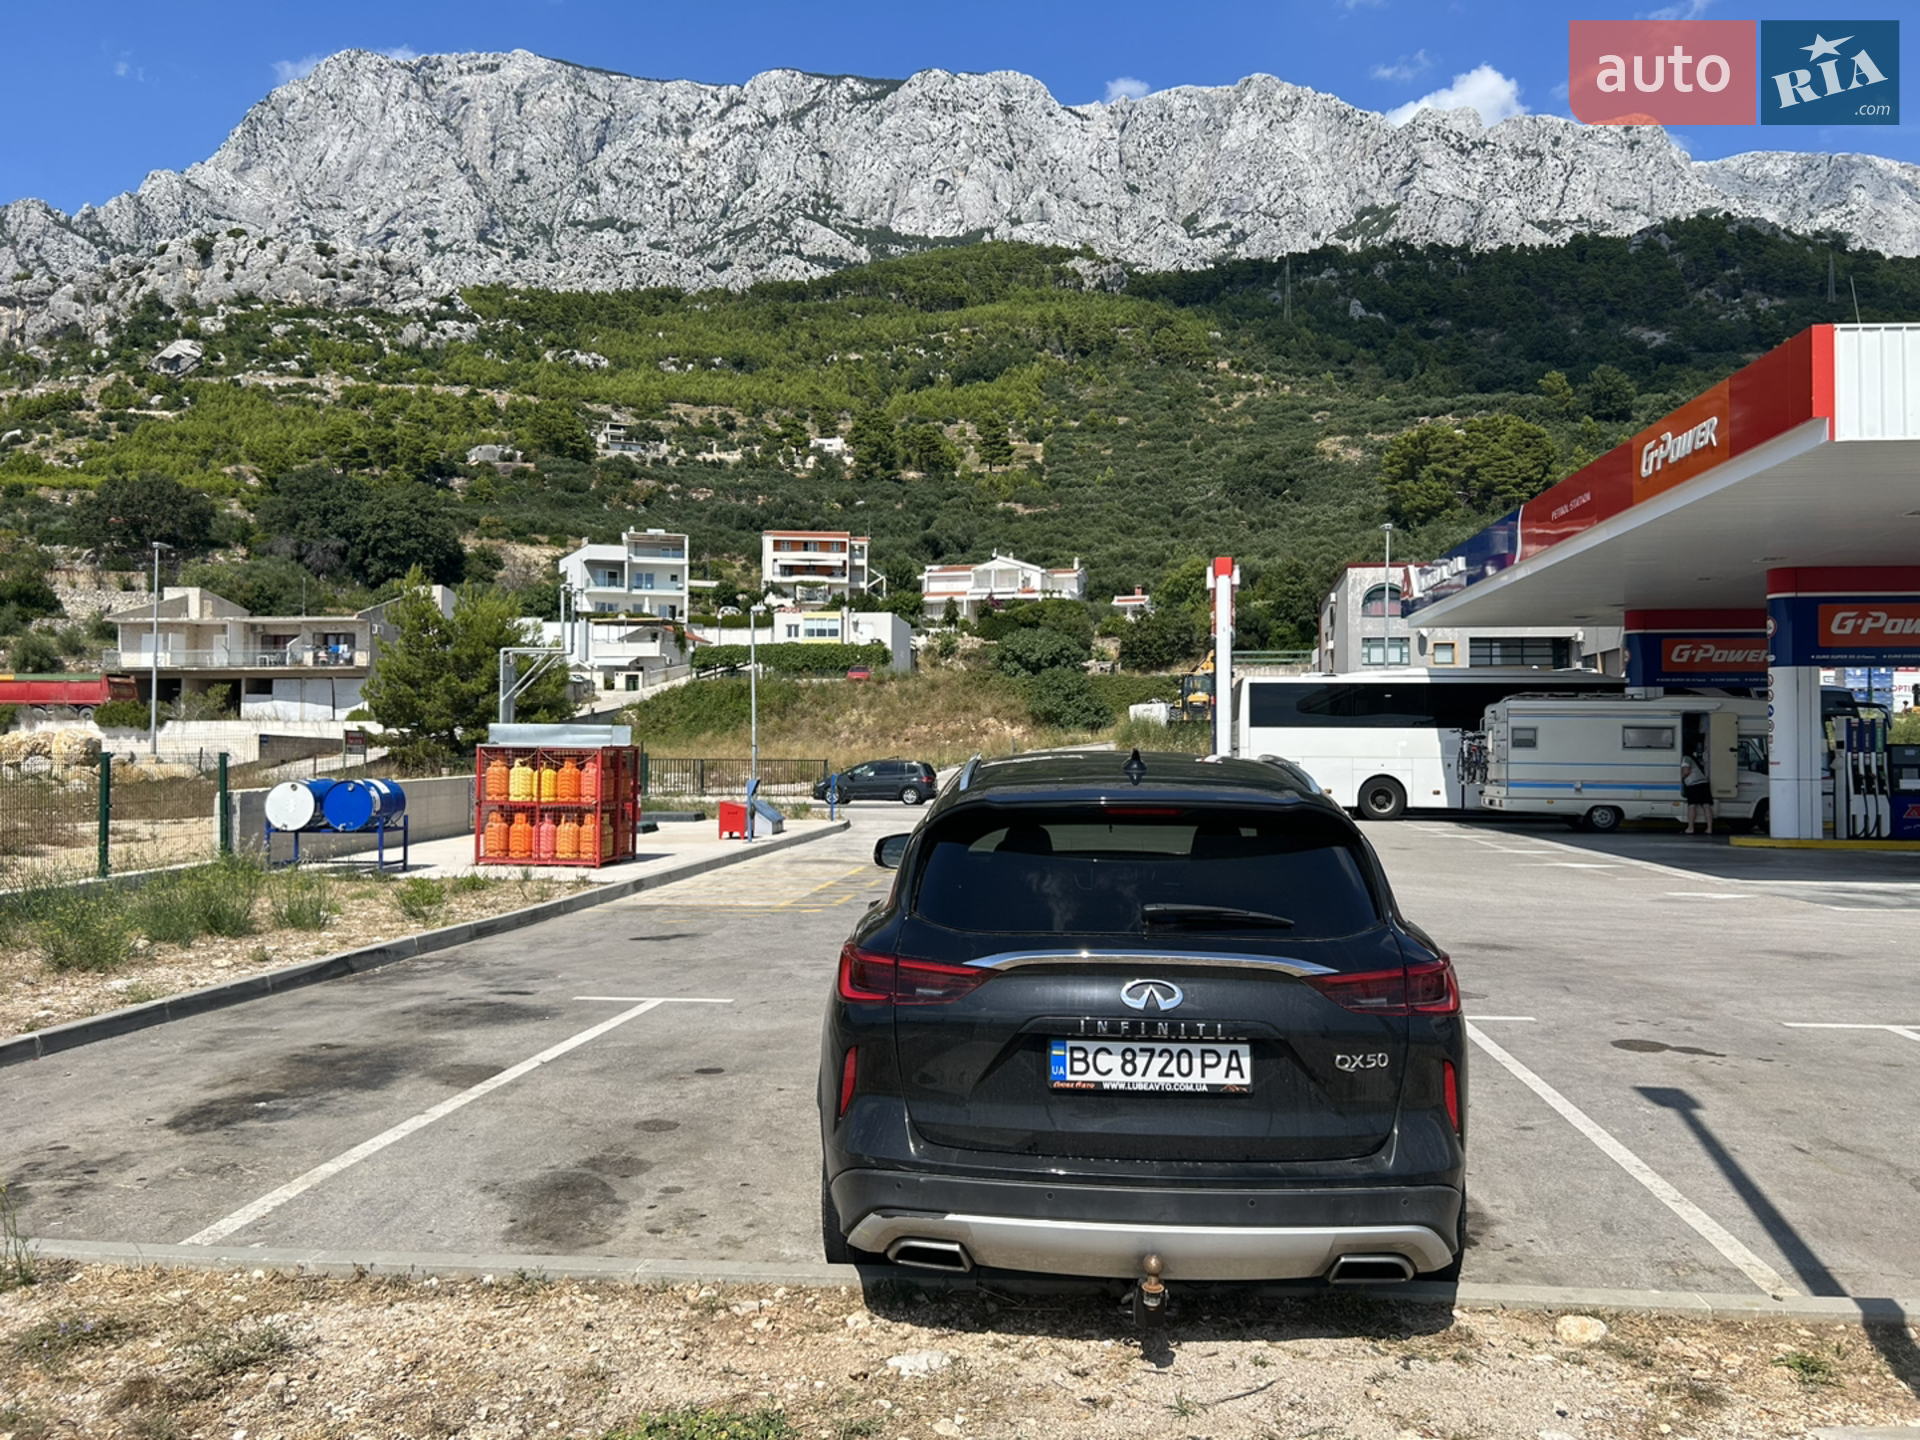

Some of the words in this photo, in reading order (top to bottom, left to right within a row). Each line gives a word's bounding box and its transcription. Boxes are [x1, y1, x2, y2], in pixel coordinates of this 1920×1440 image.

[1080, 1020, 1222, 1036] INFINITI
[1051, 1065, 1065, 1075] UA
[1335, 1052, 1389, 1073] QX50
